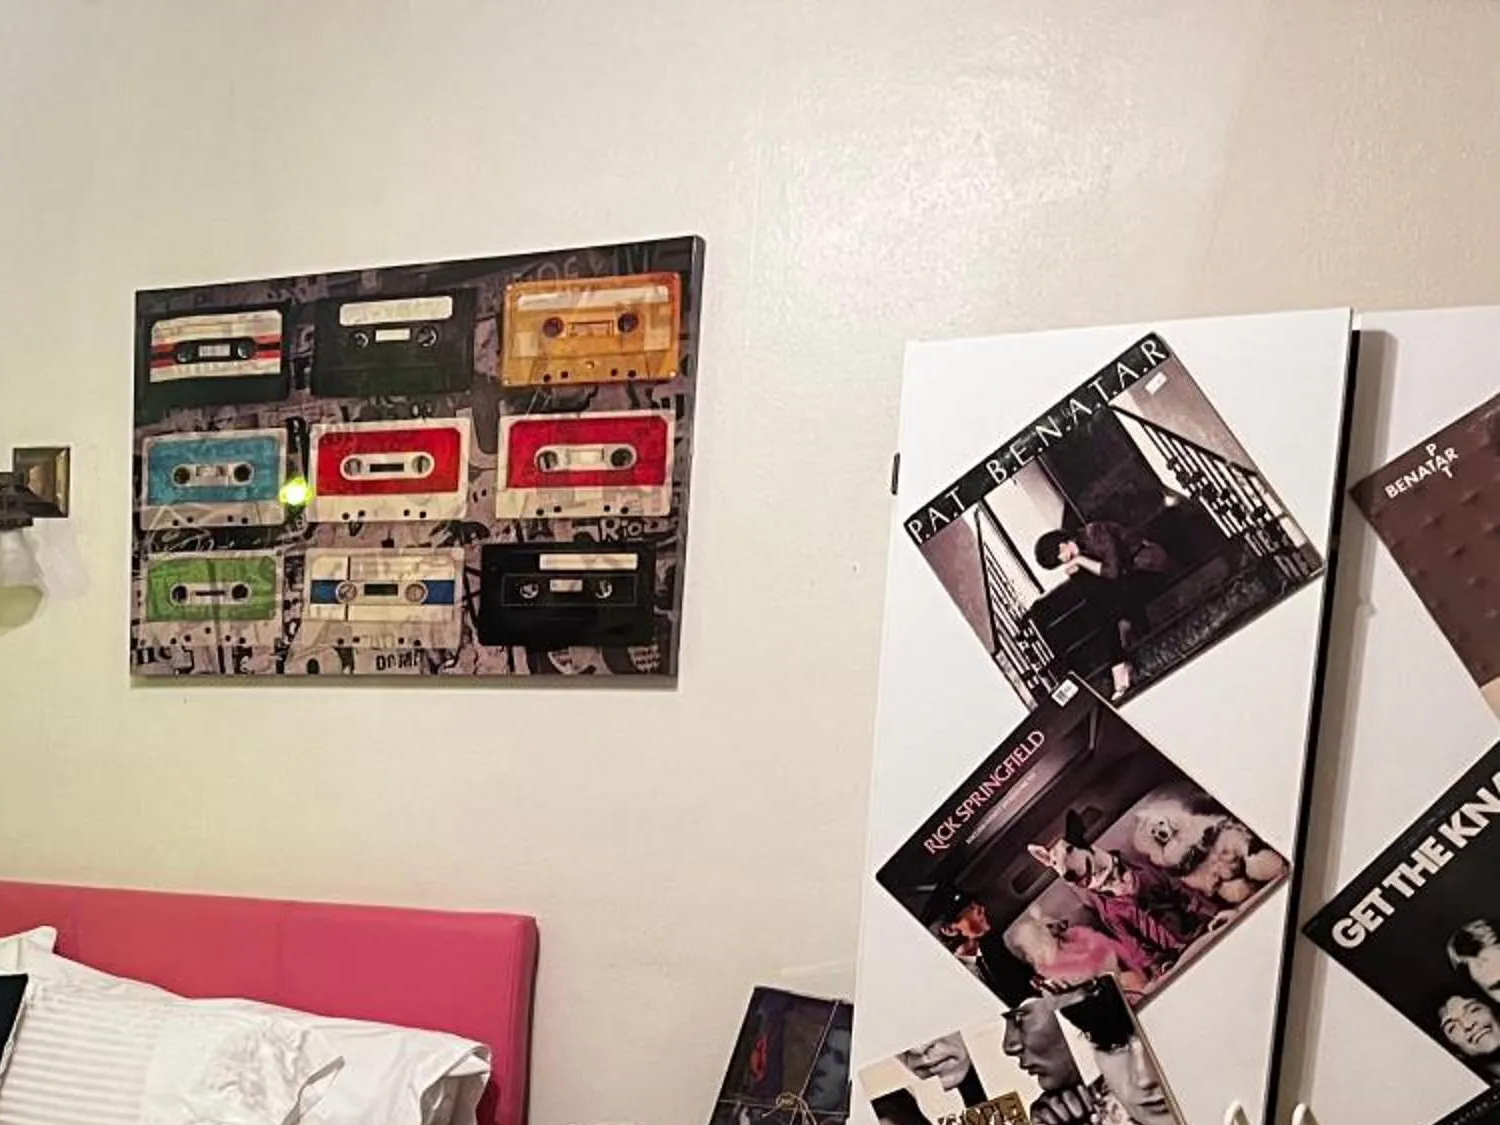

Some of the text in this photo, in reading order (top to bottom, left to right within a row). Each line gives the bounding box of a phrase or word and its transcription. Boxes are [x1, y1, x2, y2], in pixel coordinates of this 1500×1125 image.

[1384, 447, 1459, 499] BENATAR
[923, 816, 962, 854] RICK
[955, 730, 1045, 822] SPRINGFIELD
[1331, 887, 1395, 948] GET
[1381, 835, 1455, 898] THE
